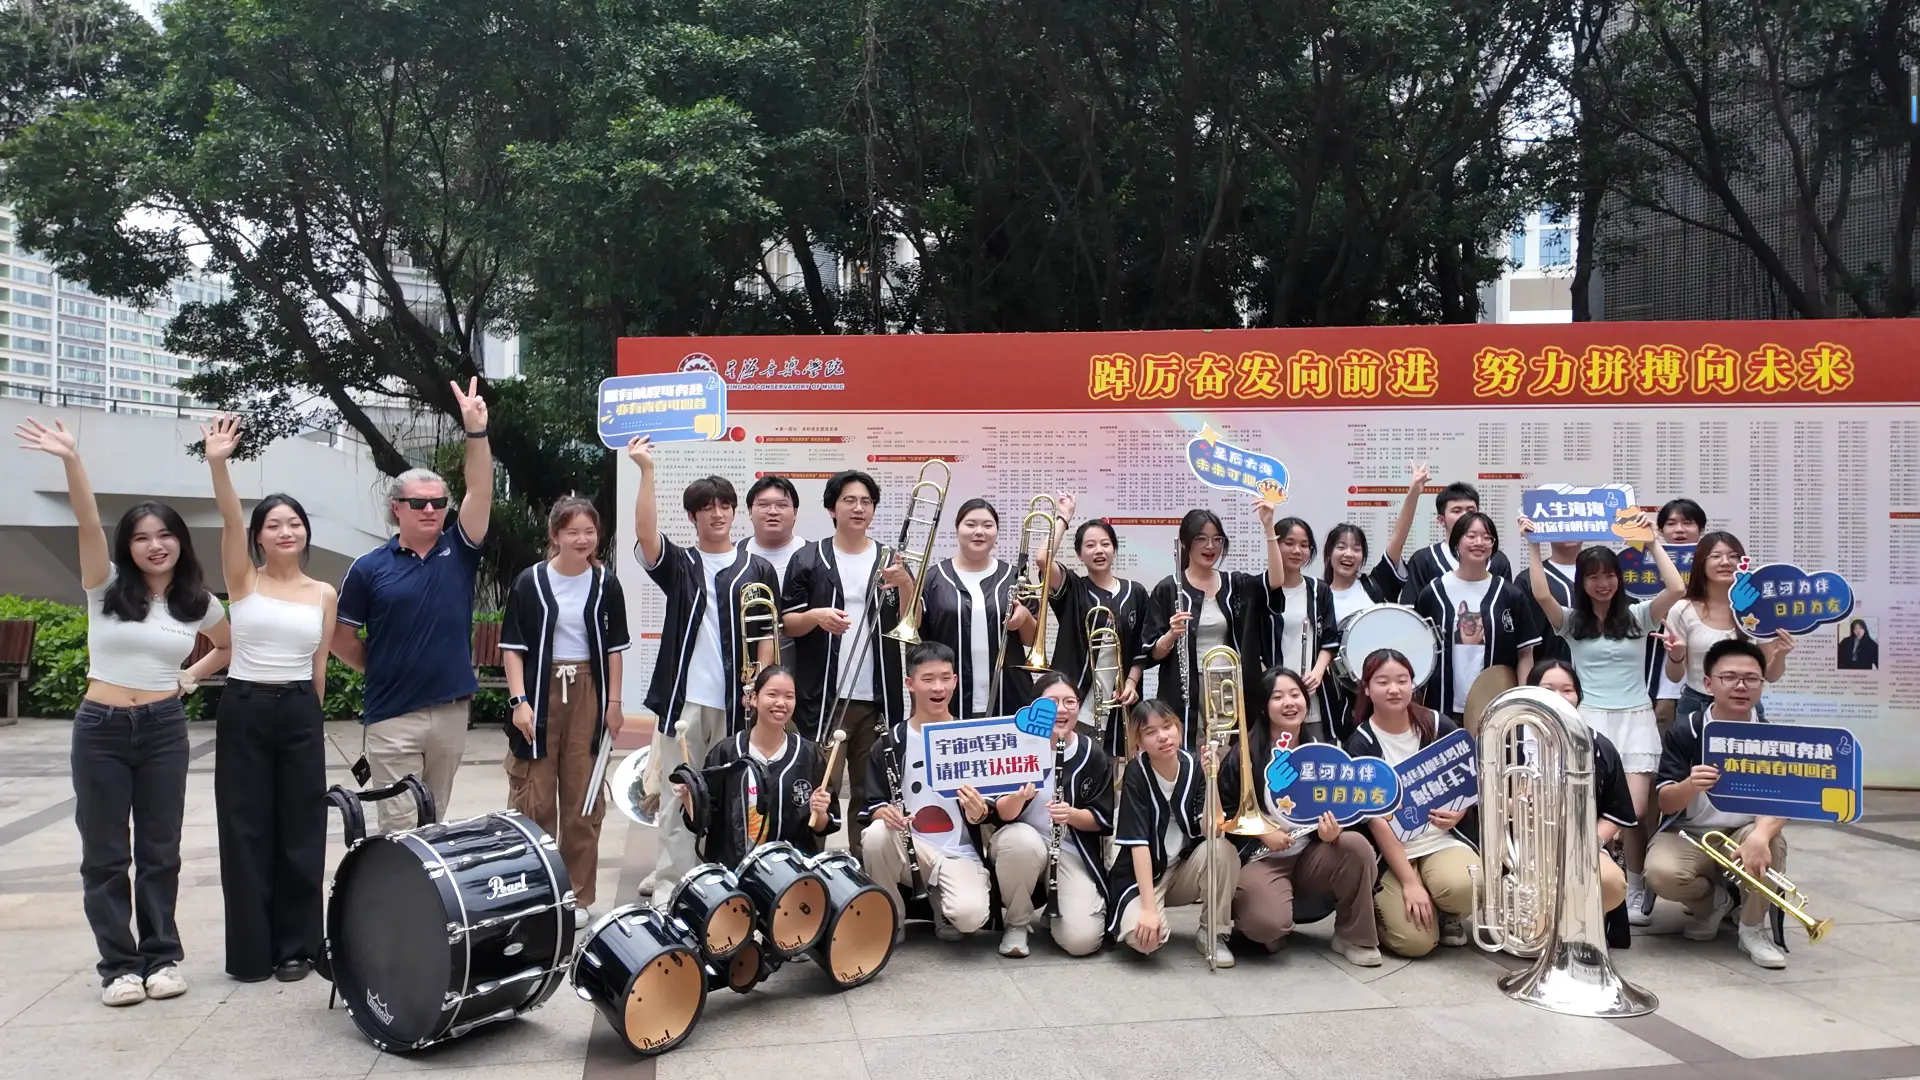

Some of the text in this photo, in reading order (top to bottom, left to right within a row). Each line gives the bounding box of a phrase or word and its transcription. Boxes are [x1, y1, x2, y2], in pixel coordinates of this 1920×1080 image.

[1089, 342, 1855, 400] 踔厉奋发向前进 努力拼搏向未来
[1213, 445, 1273, 477] 星辰大海
[1195, 457, 1257, 488] 未来可期
[1532, 501, 1605, 519] 人生海海
[1762, 580, 1829, 599] 星河为伴
[1775, 599, 1841, 617] 日月为友
[935, 732, 1018, 756] 宇宙或星海
[936, 755, 1040, 781] 请把我认出来
[1301, 763, 1376, 782] 星河为伴
[1723, 757, 1838, 780] 亦有青春可回首
[1312, 787, 1387, 804] 日月为友
[486, 872, 529, 900] Pearl
[708, 936, 736, 952] Pearl
[779, 935, 805, 949] Pearl
[838, 966, 866, 982] Pearl
[639, 1029, 674, 1049] Pearl
